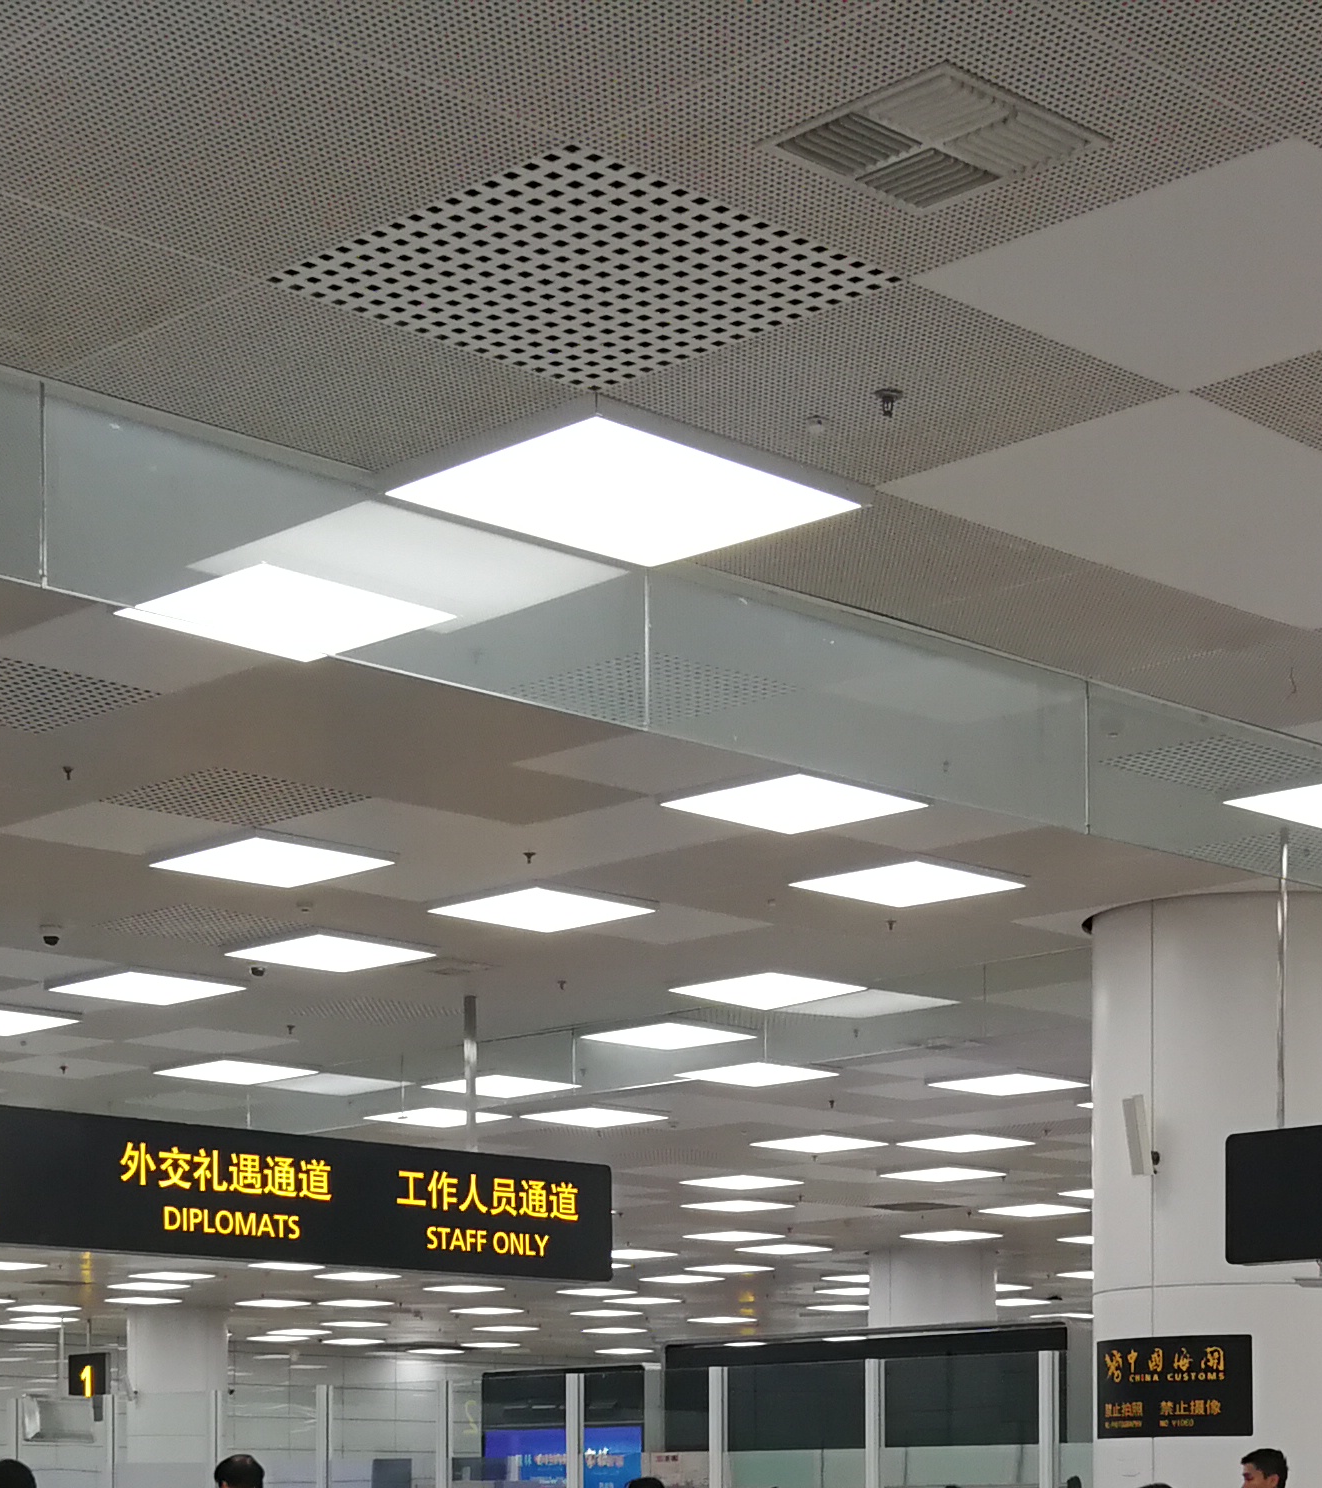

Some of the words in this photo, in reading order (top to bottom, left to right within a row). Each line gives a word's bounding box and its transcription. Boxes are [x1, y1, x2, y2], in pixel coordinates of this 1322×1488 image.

[119, 1141, 333, 1202] 外交礼遇通道
[396, 1169, 579, 1222] 工作人员通道
[163, 1205, 301, 1240] DIPLOMATS
[426, 1225, 488, 1253] STAFF
[492, 1231, 550, 1257] ONLY
[79, 1364, 95, 1398] 1
[1129, 1373, 1160, 1383] CHINA
[1167, 1372, 1226, 1382] CUSTOMS
[1159, 1399, 1222, 1416] 禁止摄像
